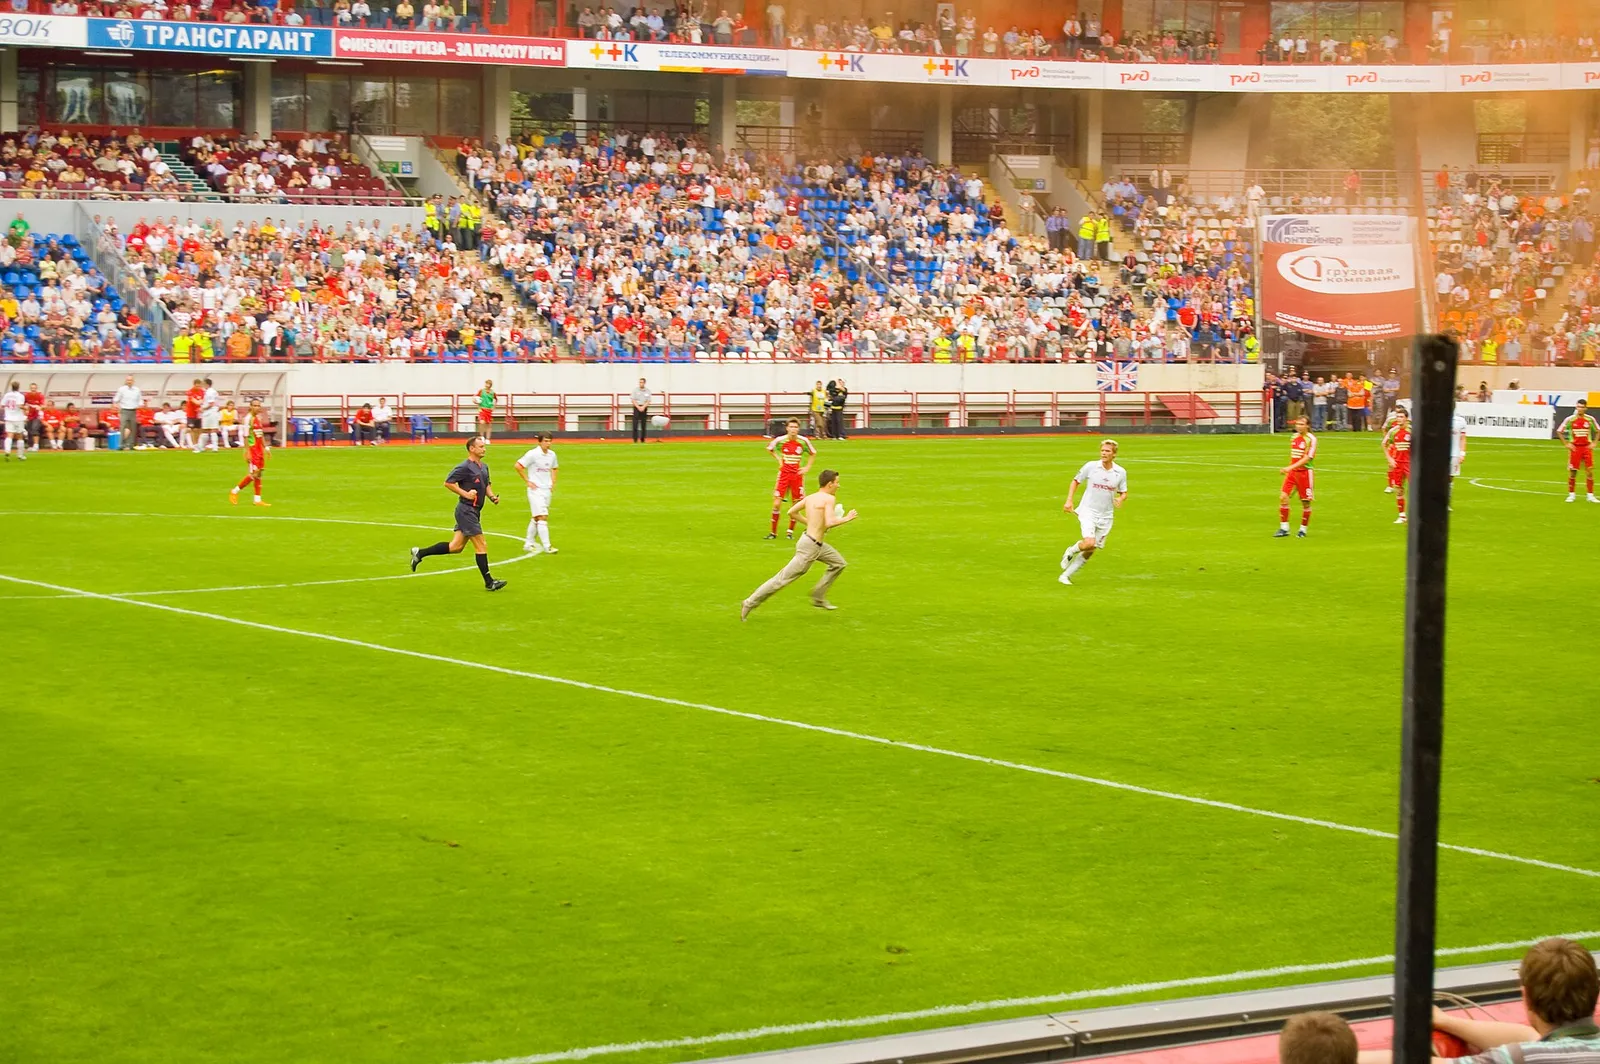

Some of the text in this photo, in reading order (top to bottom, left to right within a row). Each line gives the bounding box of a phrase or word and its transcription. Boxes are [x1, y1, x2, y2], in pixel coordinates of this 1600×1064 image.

[143, 25, 315, 52] ТРАНСГАРАНТ
[339, 36, 447, 55] ФИНЭКСПЕРТИЗА
[473, 43, 528, 59] КРАСОТУ
[528, 45, 563, 60] ИГРЫ
